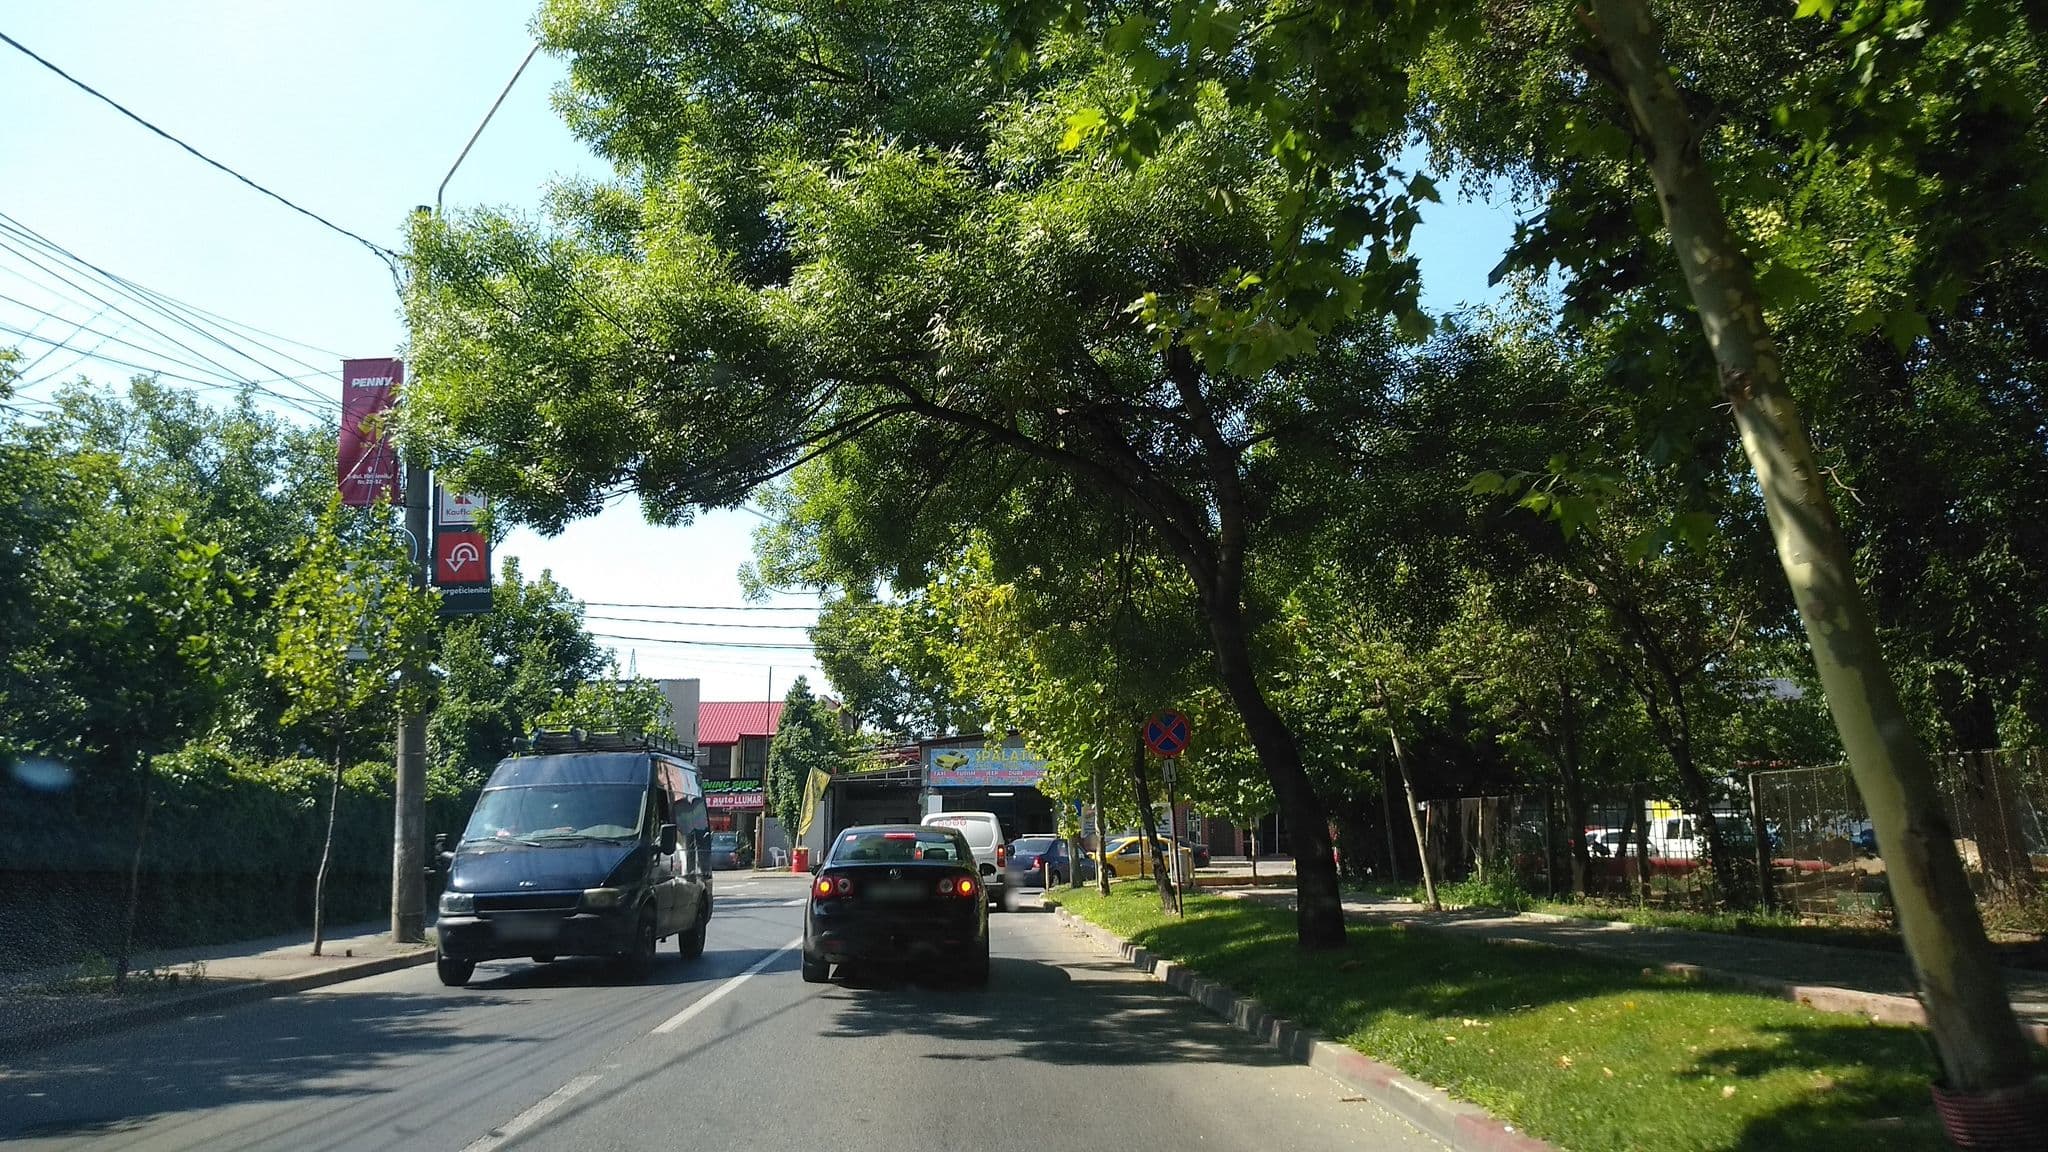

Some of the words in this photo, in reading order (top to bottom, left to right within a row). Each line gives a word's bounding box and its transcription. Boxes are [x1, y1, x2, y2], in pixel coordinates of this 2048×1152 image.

[446, 508, 471, 517] Kaufla
[441, 586, 491, 596] ergeticienilor
[703, 780, 730, 789] NING
[733, 780, 759, 789] SHOP
[712, 796, 734, 805] auto
[734, 795, 762, 805] LLUMAR
